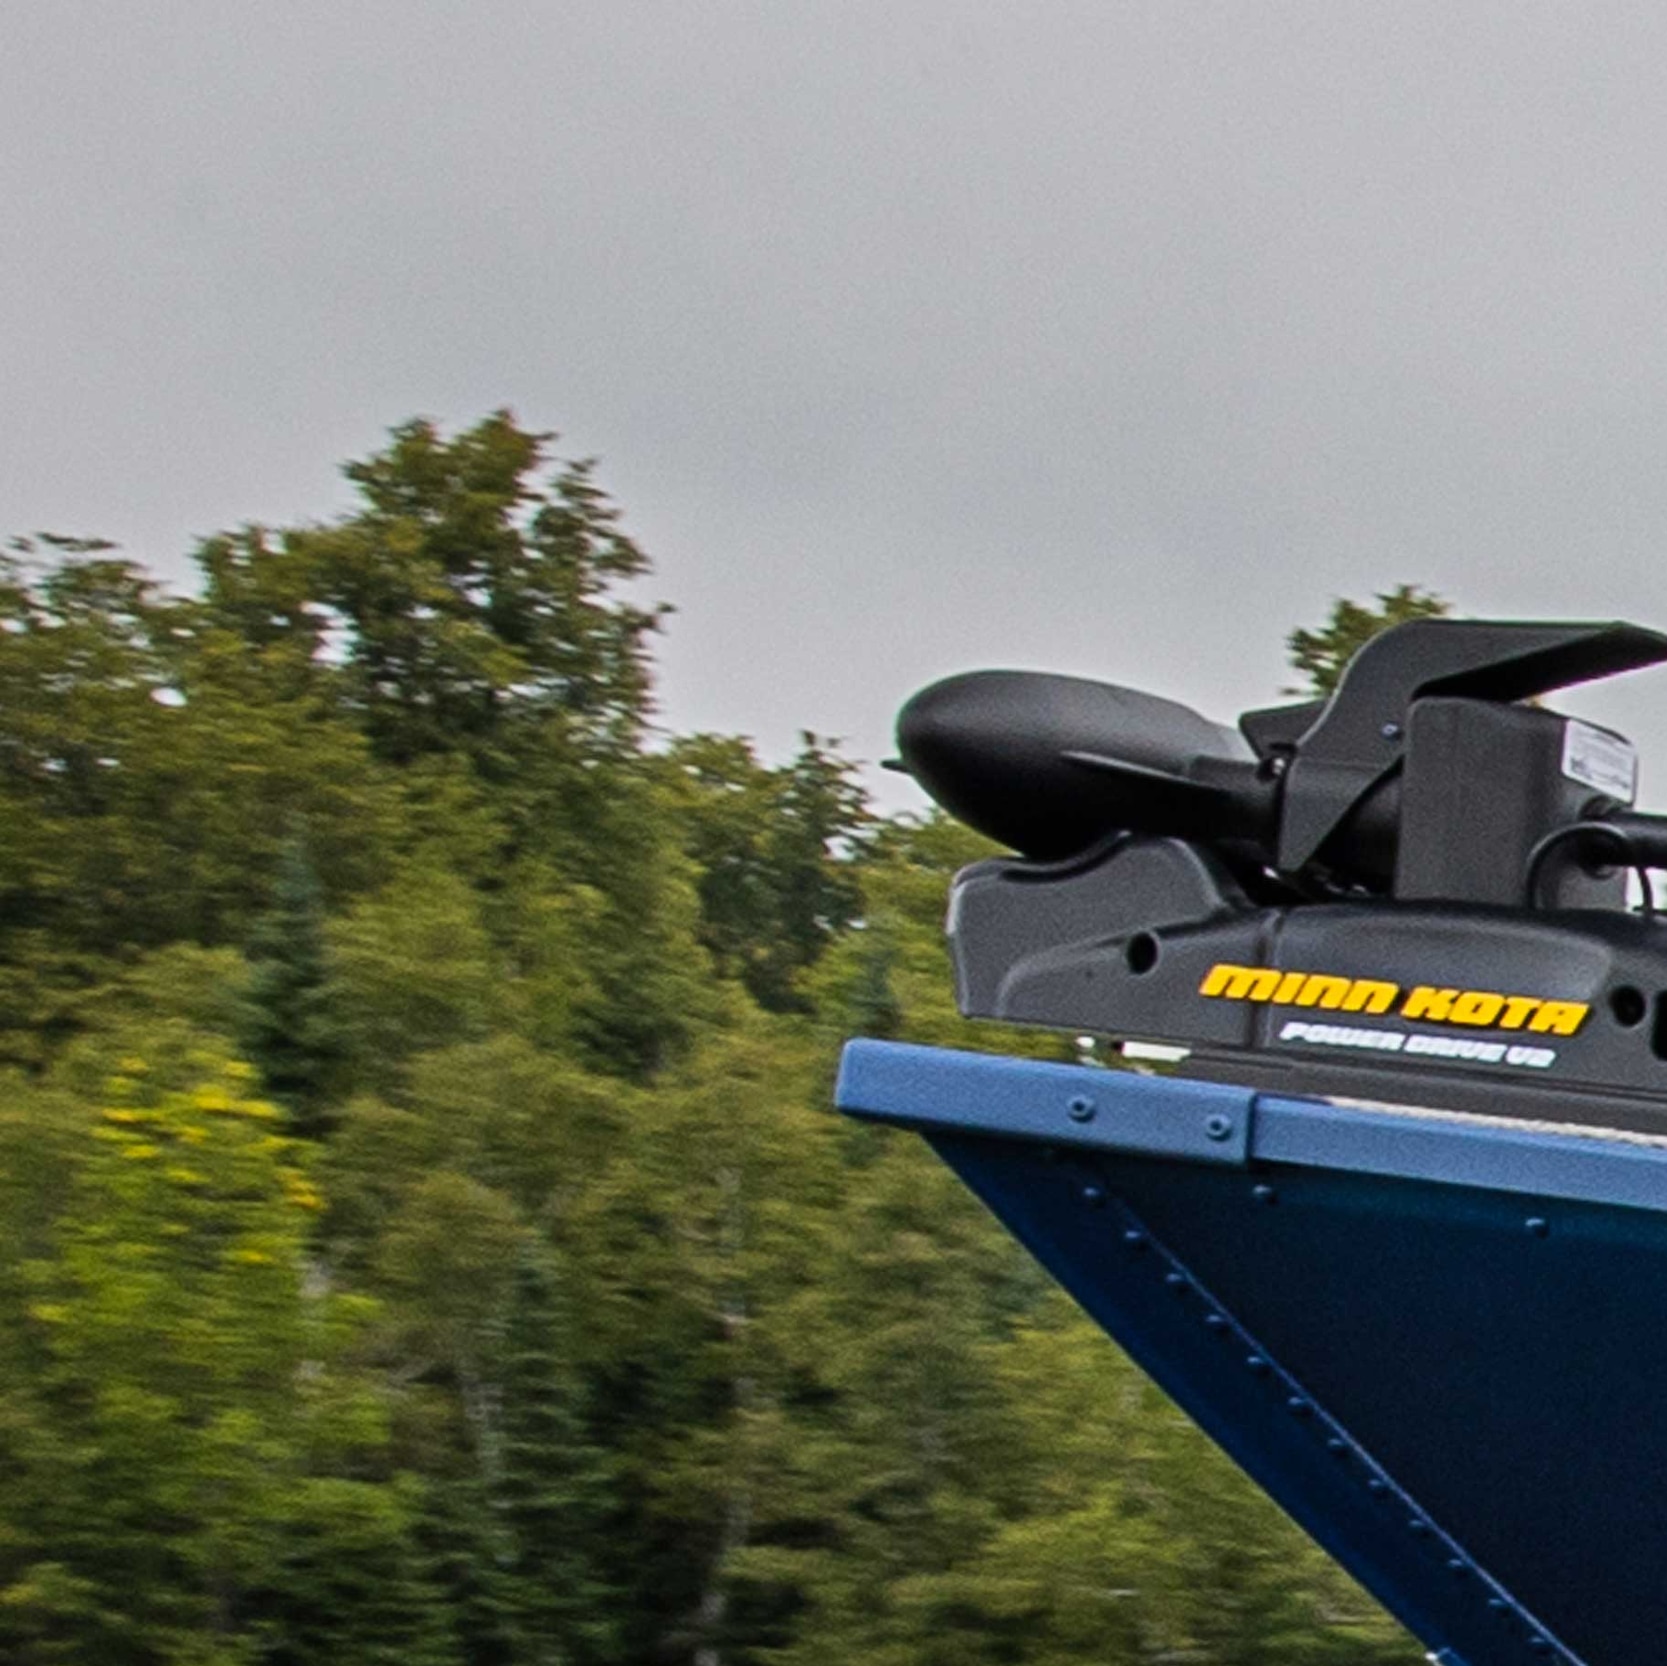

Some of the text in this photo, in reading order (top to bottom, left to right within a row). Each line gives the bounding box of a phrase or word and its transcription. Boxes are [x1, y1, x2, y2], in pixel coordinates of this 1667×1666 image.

[1201, 964, 1588, 1035] MINN KOTA
[1279, 1022, 1404, 1050] POWER
[1404, 1035, 1507, 1062] DRIVE
